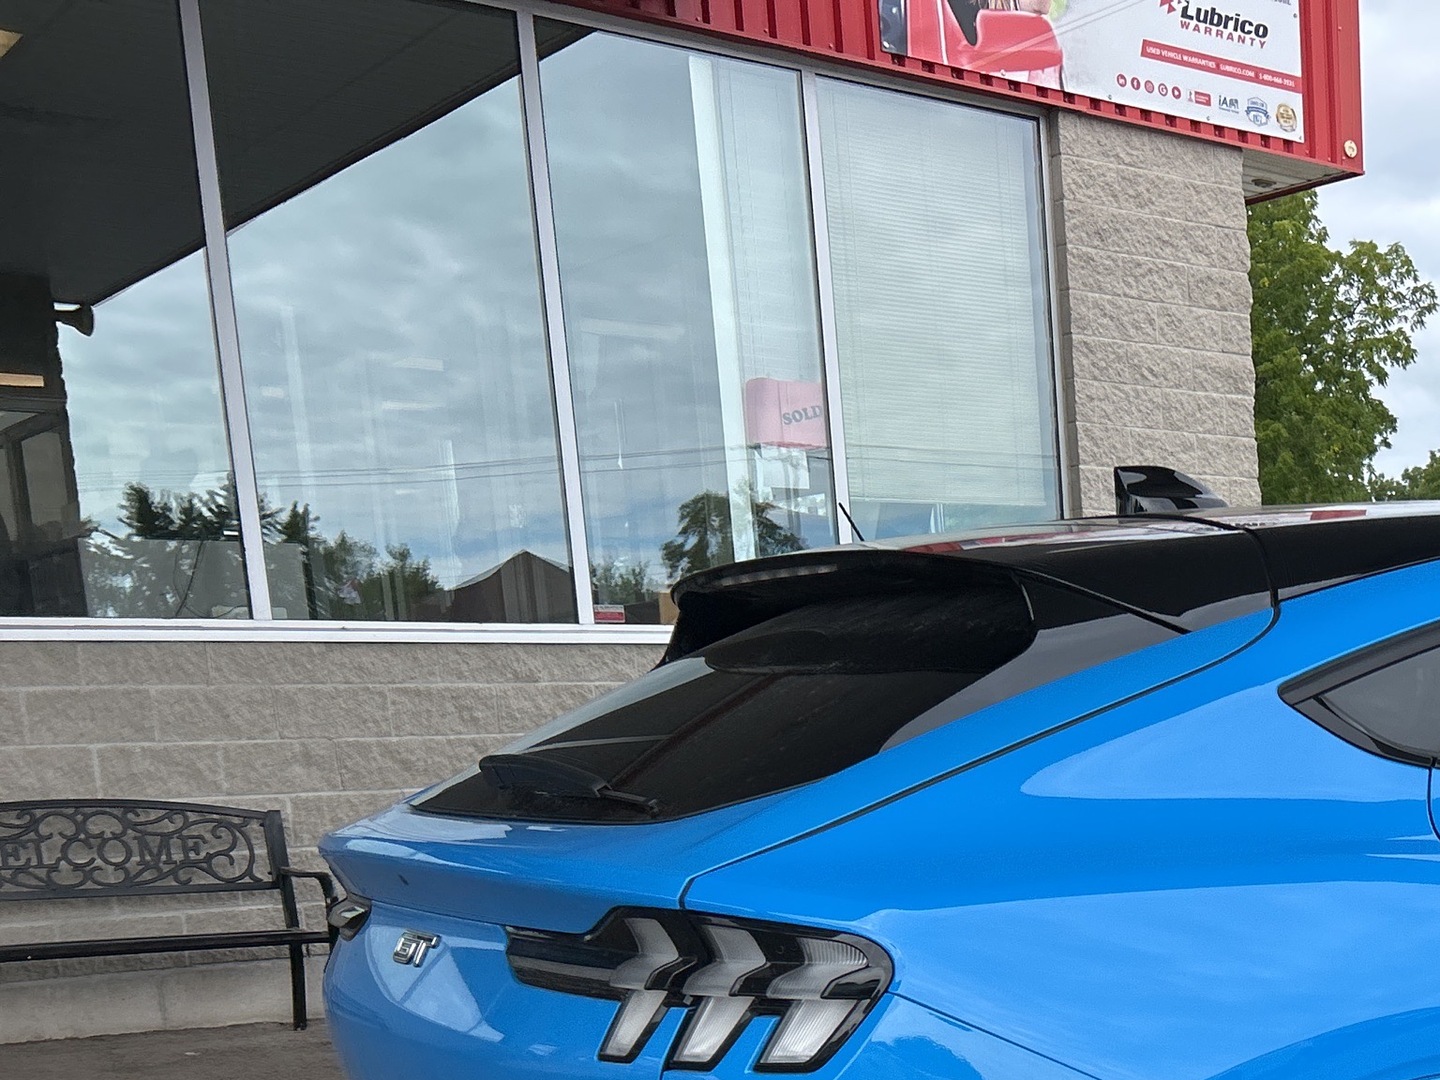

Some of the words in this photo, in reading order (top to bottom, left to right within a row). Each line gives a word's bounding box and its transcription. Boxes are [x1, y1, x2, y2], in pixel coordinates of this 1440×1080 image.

[1180, 1, 1269, 39] Lubrico
[1180, 20, 1267, 49] WARRANTY
[1146, 46, 1161, 55] USED
[1161, 49, 1182, 61] VEHICLE
[782, 405, 822, 426] SOLD
[393, 928, 442, 968] GT
